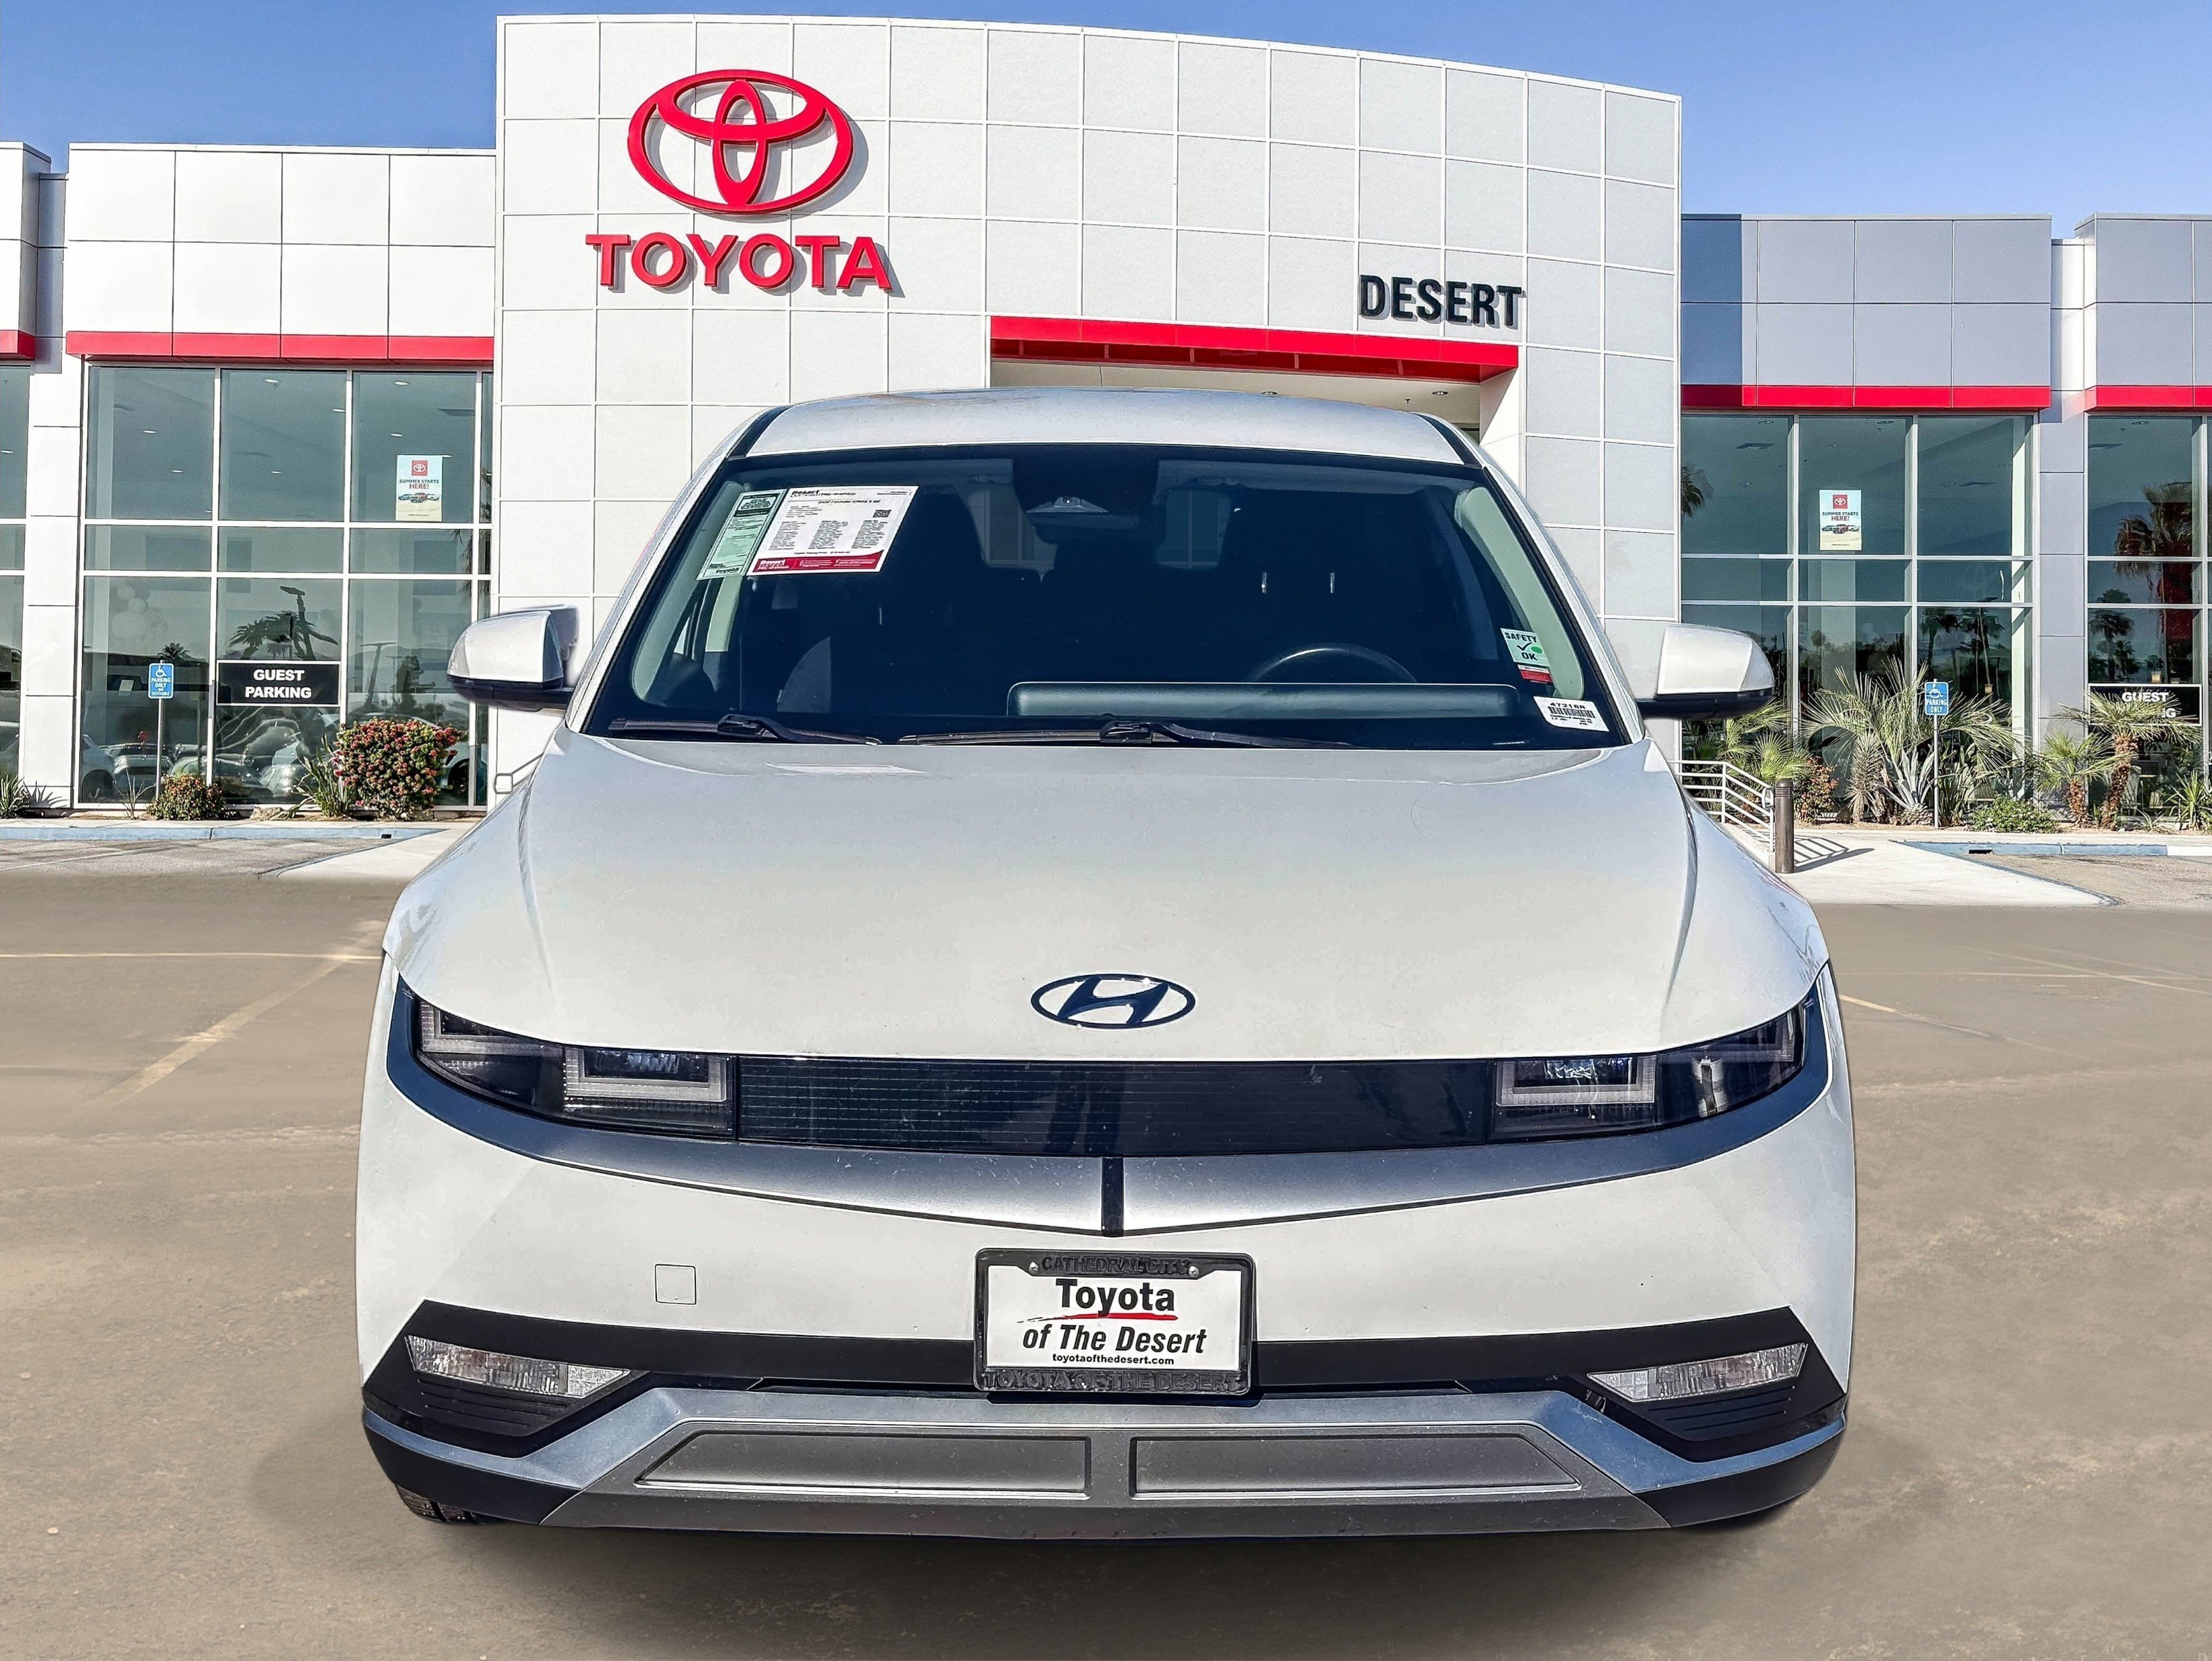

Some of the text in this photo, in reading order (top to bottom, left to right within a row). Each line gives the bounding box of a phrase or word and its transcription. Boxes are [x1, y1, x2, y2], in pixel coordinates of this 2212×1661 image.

[585, 232, 893, 291] TOYOTA
[1359, 274, 1522, 327] DESERT
[1505, 632, 1537, 643] SAFETY
[1521, 652, 1538, 661] OK
[253, 669, 305, 681] GUEST
[245, 687, 312, 699] PARKING
[2121, 692, 2169, 703] GUEST
[1042, 1256, 1144, 1274] CATHEDRAL
[1056, 1278, 1174, 1317] Toyota
[1022, 1323, 1207, 1354] of The Desert
[1052, 1354, 1174, 1366] toyotaofthedesert.com
[985, 1370, 1072, 1389] TOYOTA
[1109, 1372, 1152, 1390] THE
[1154, 1372, 1242, 1392] DESERT
